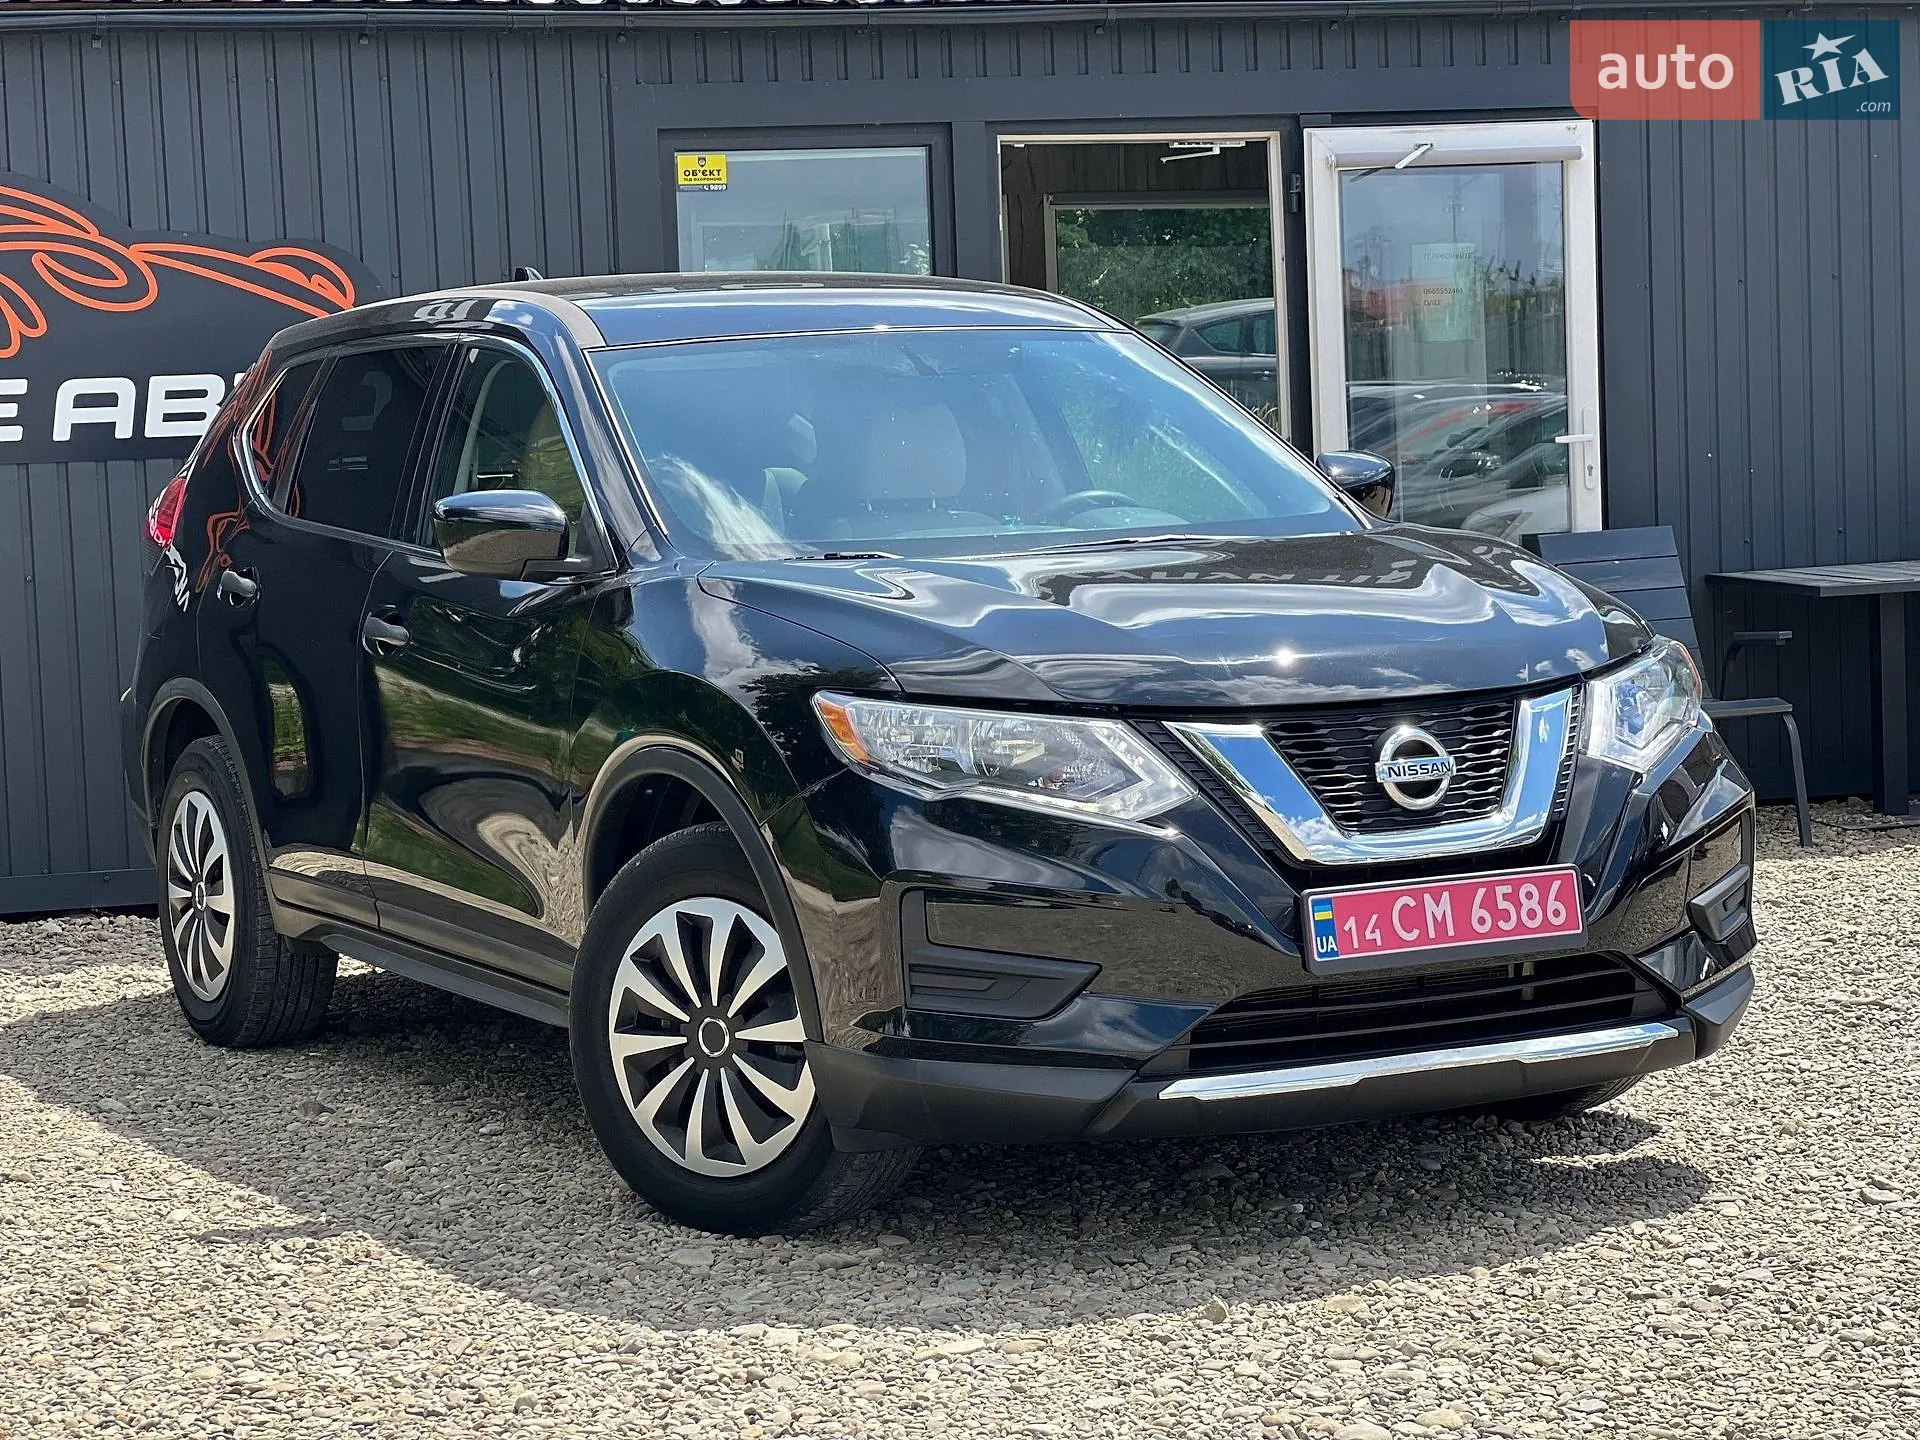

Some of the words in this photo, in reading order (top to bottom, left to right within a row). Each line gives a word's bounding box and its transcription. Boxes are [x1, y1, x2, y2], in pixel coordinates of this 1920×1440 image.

[683, 169, 722, 177] ОБ'ЄКТ
[53, 372, 246, 442] АВ
[1386, 761, 1451, 778] NISSAN
[1471, 879, 1567, 934] 6586
[1317, 935, 1338, 954] UA
